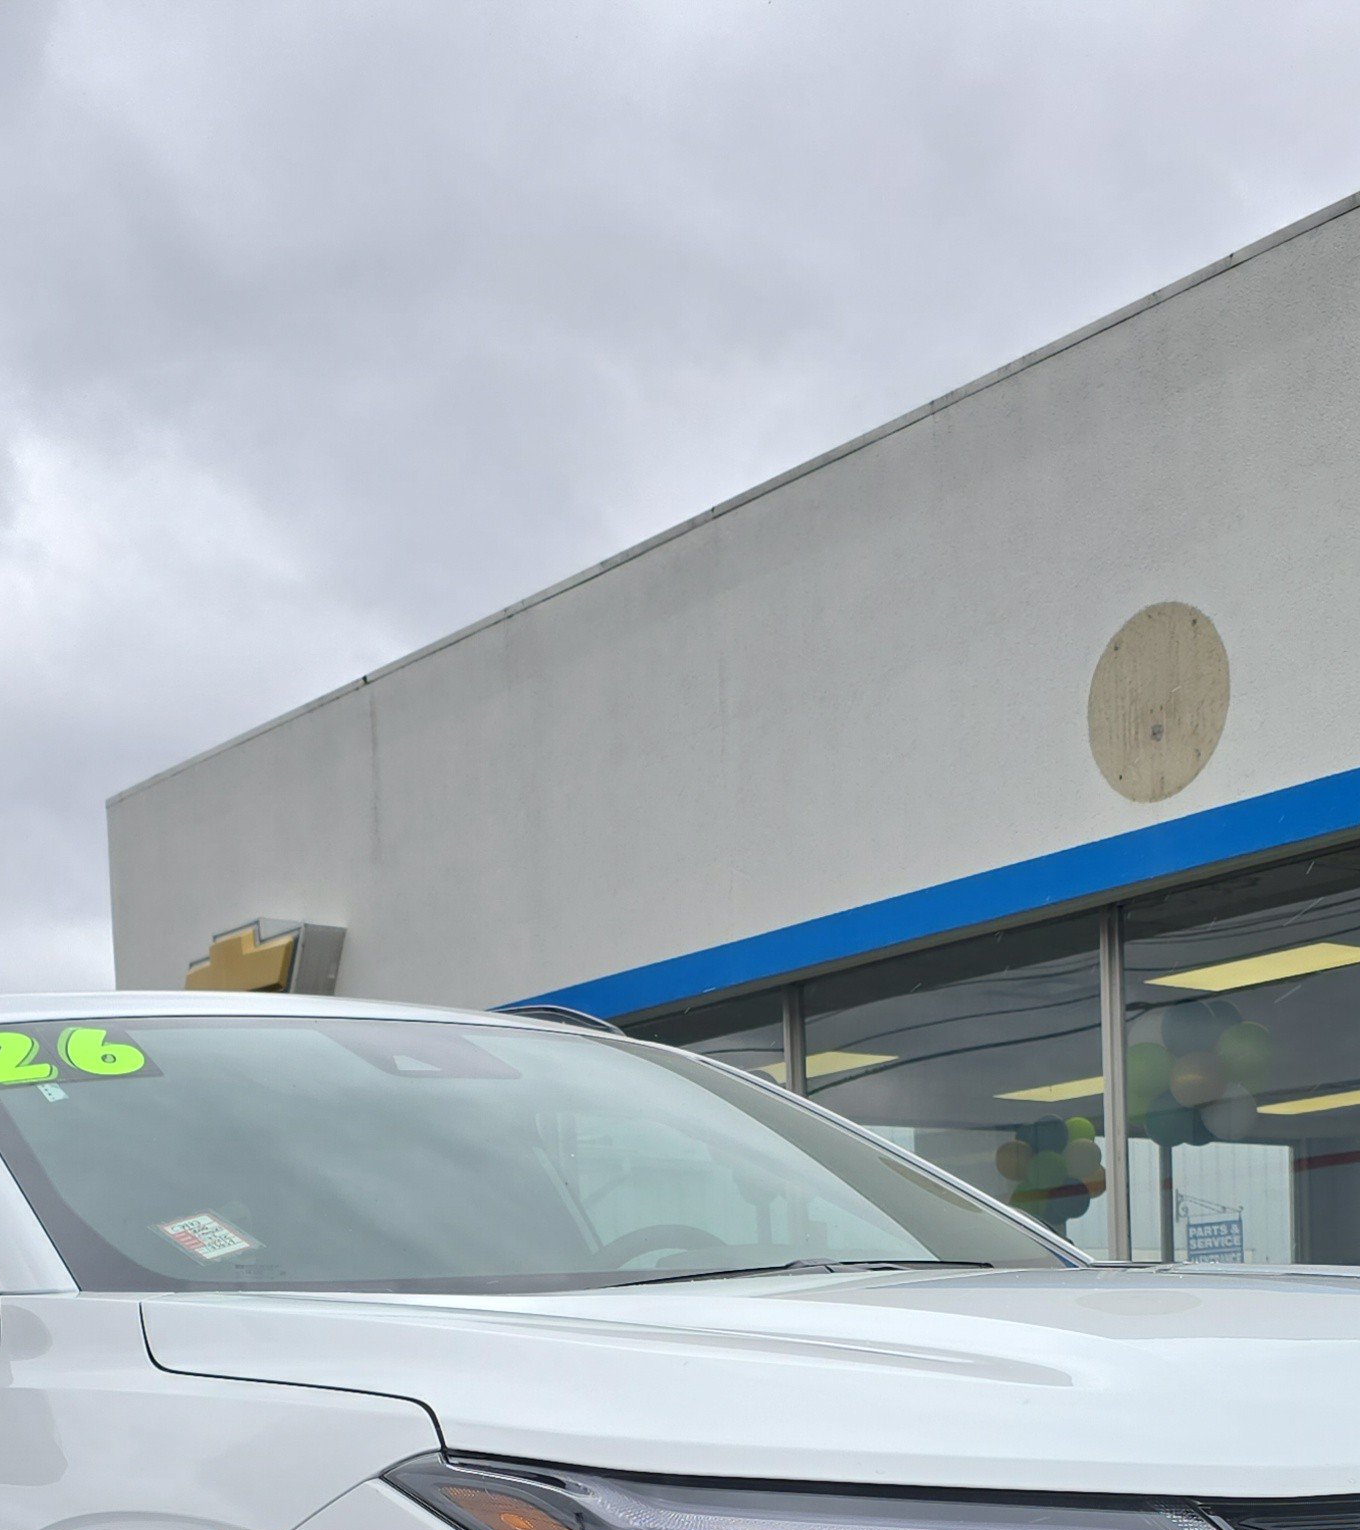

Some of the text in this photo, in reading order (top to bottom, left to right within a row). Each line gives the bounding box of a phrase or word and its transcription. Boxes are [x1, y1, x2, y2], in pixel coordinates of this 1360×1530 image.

[1188, 1224, 1240, 1237] PARTS &
[1189, 1235, 1241, 1249] SERVICE
